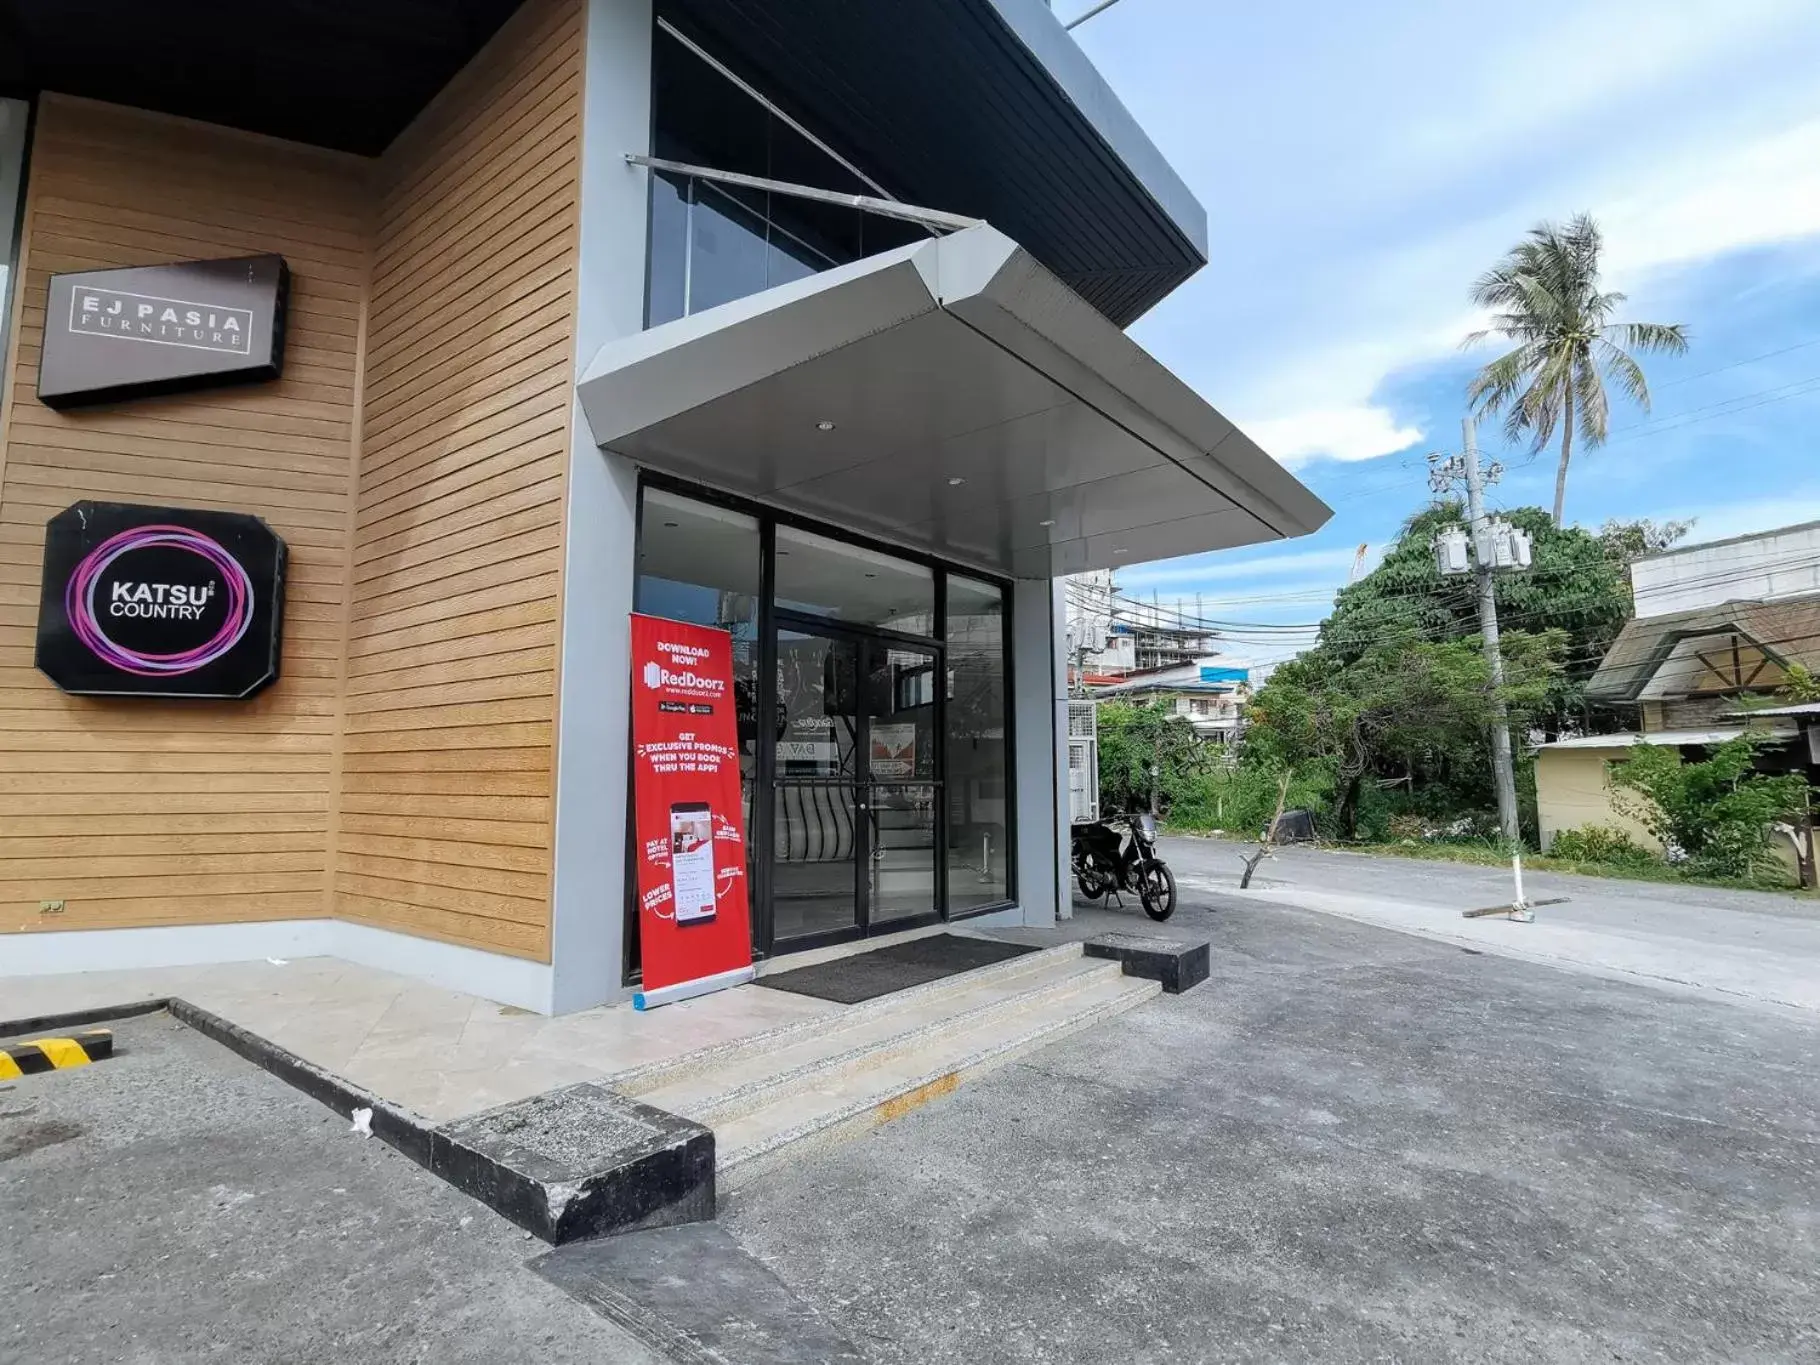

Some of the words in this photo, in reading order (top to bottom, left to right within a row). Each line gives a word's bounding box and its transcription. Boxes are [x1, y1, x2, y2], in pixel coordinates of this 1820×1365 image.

[83, 295, 123, 315] EJ
[138, 304, 240, 331] PASIA
[81, 314, 241, 345] FURNITURE
[112, 581, 208, 605] KATSU
[110, 602, 205, 620] COUNTRY
[658, 641, 710, 657] DOWNLOAD
[672, 655, 697, 666] NOW!
[661, 669, 724, 690] RedDoorz
[679, 732, 695, 740] GET
[646, 742, 692, 753] EXCLUSIVE
[694, 743, 728, 755] PROMOS
[650, 752, 676, 762] WHEN
[678, 753, 696, 762] YOU
[697, 753, 721, 763] BOOK
[653, 763, 677, 773] THRU
[679, 762, 696, 773] THE
[643, 883, 670, 902] LOWER
[645, 890, 672, 910] PRICES
